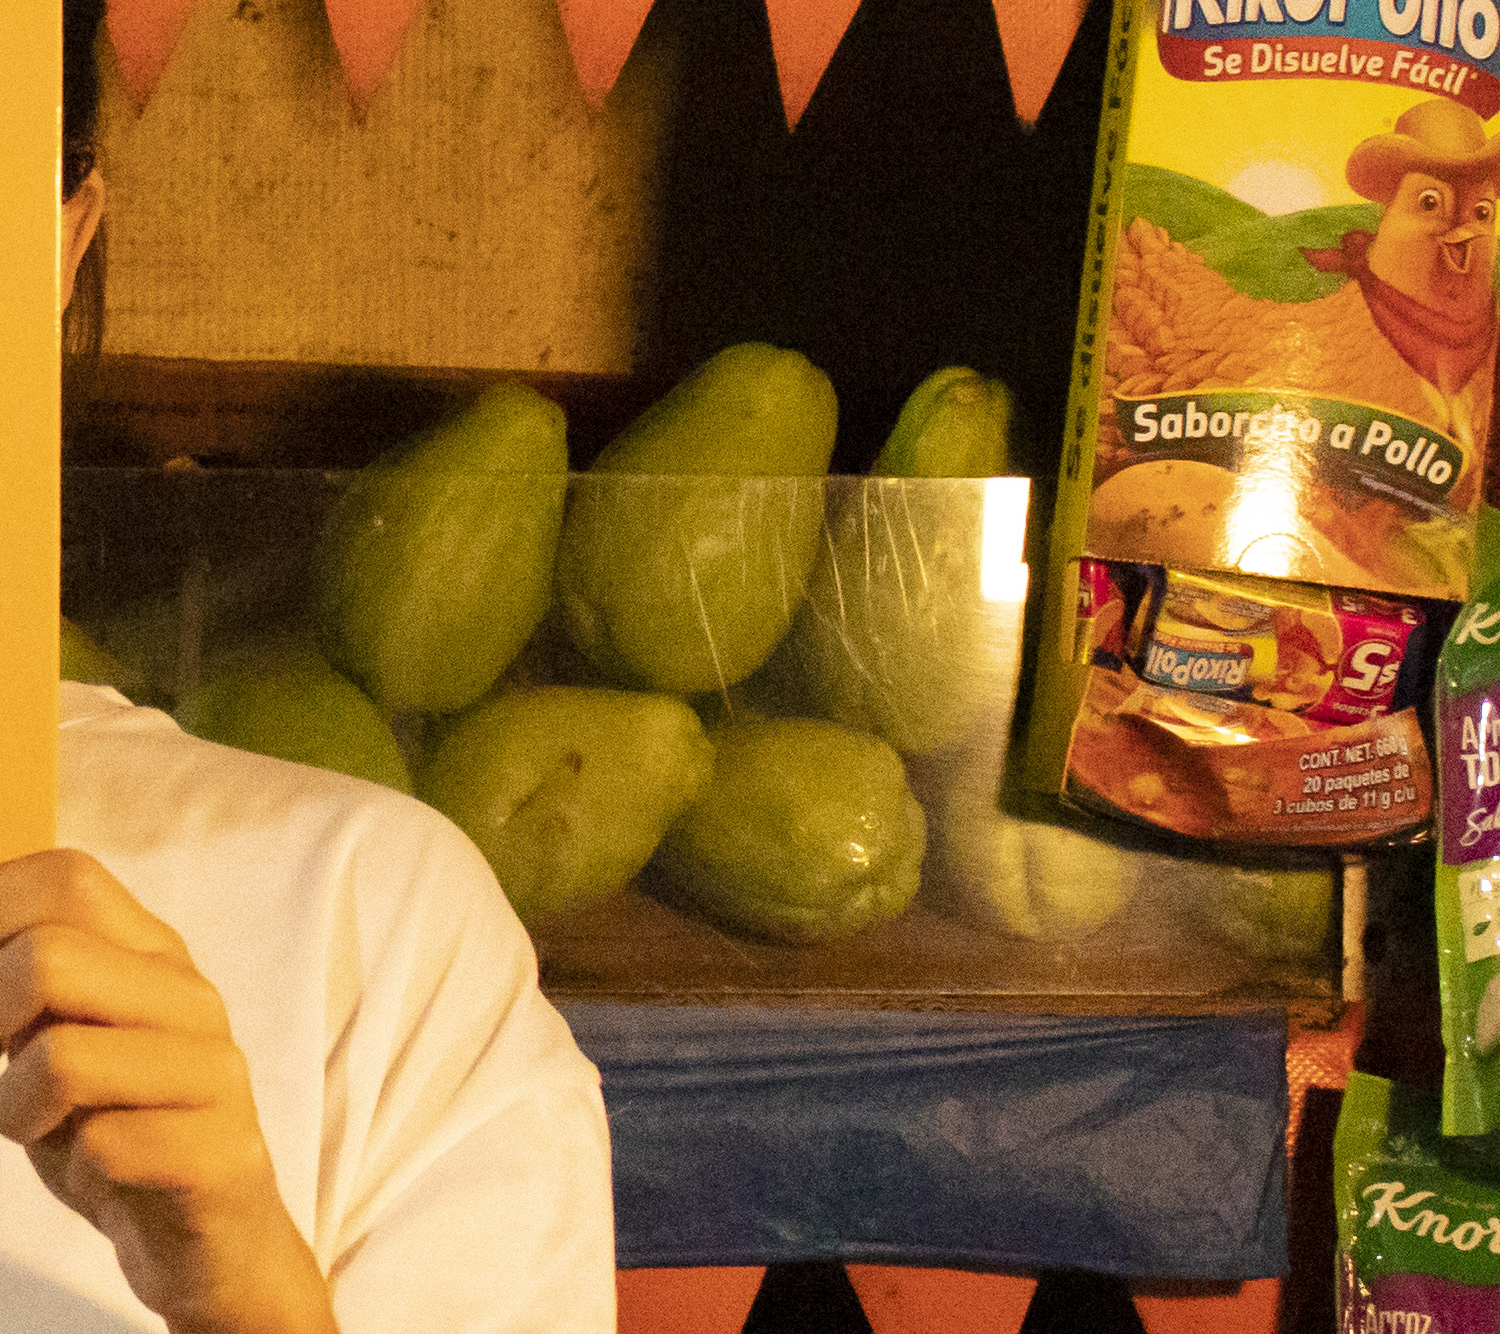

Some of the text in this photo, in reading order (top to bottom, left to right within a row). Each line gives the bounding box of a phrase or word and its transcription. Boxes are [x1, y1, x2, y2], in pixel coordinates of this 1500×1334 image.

[1203, 44, 1469, 96] Se Disuelve Fácil
[1330, 422, 1356, 450] a
[1361, 420, 1453, 486] Pollo
[1299, 749, 1341, 771] CONT.
[1345, 742, 1373, 763] NET.
[1303, 762, 1410, 794] 20 paquetes de
[1273, 799, 1282, 814] 3
[1286, 798, 1334, 814] cubos
[1338, 795, 1358, 811] de
[1363, 790, 1377, 807] 11
[1380, 794, 1391, 809] g
